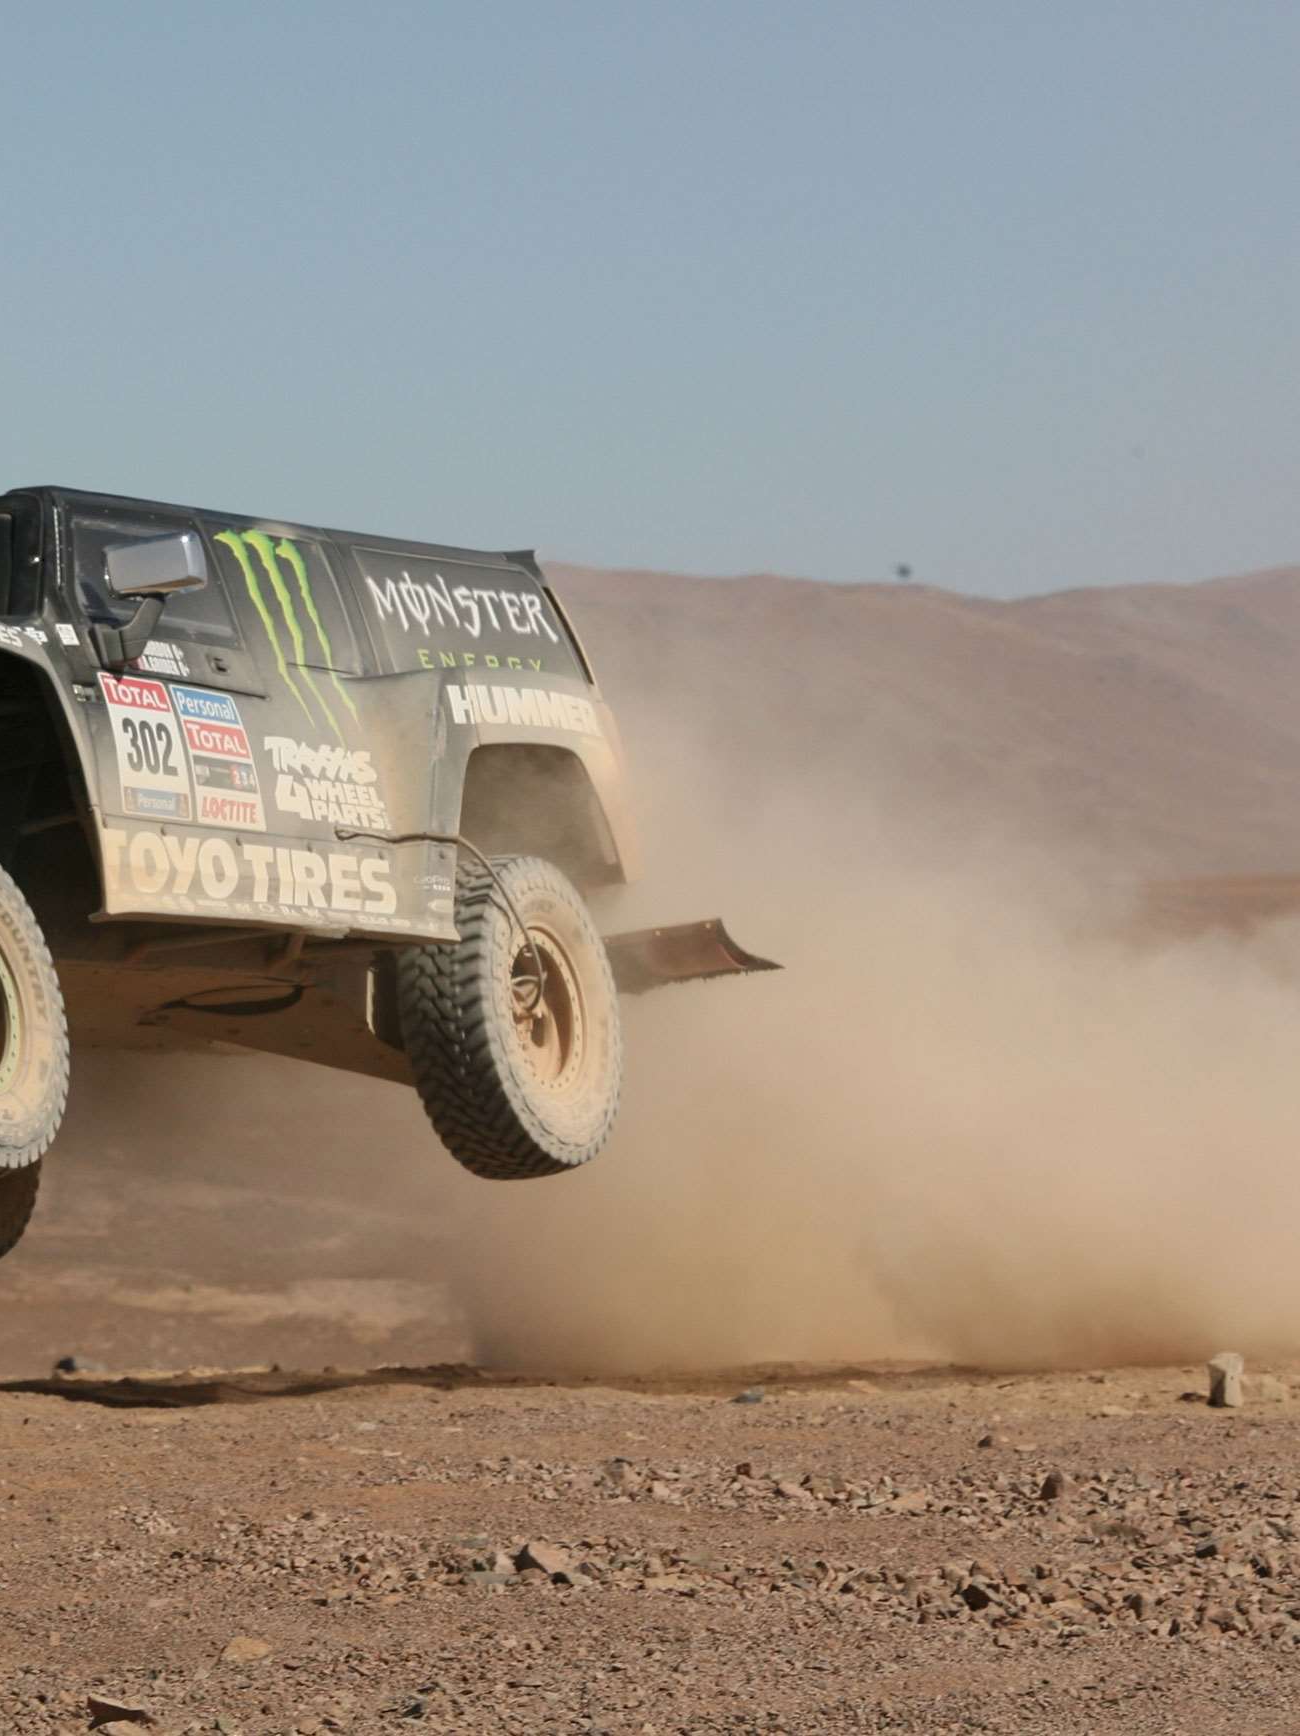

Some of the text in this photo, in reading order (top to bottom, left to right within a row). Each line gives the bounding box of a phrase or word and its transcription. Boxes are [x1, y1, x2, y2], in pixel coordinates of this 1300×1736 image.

[365, 571, 559, 643] MONSTER
[103, 677, 168, 709] TOTAL
[176, 691, 236, 721] Personal
[122, 718, 179, 777] 302
[186, 723, 248, 755] TOTAL
[202, 797, 257, 824] LOCTITE
[275, 774, 315, 820] 4
[303, 777, 386, 809] WHEEL
[311, 800, 386, 830] PARTS
[104, 829, 397, 914] TOYO TIRES
